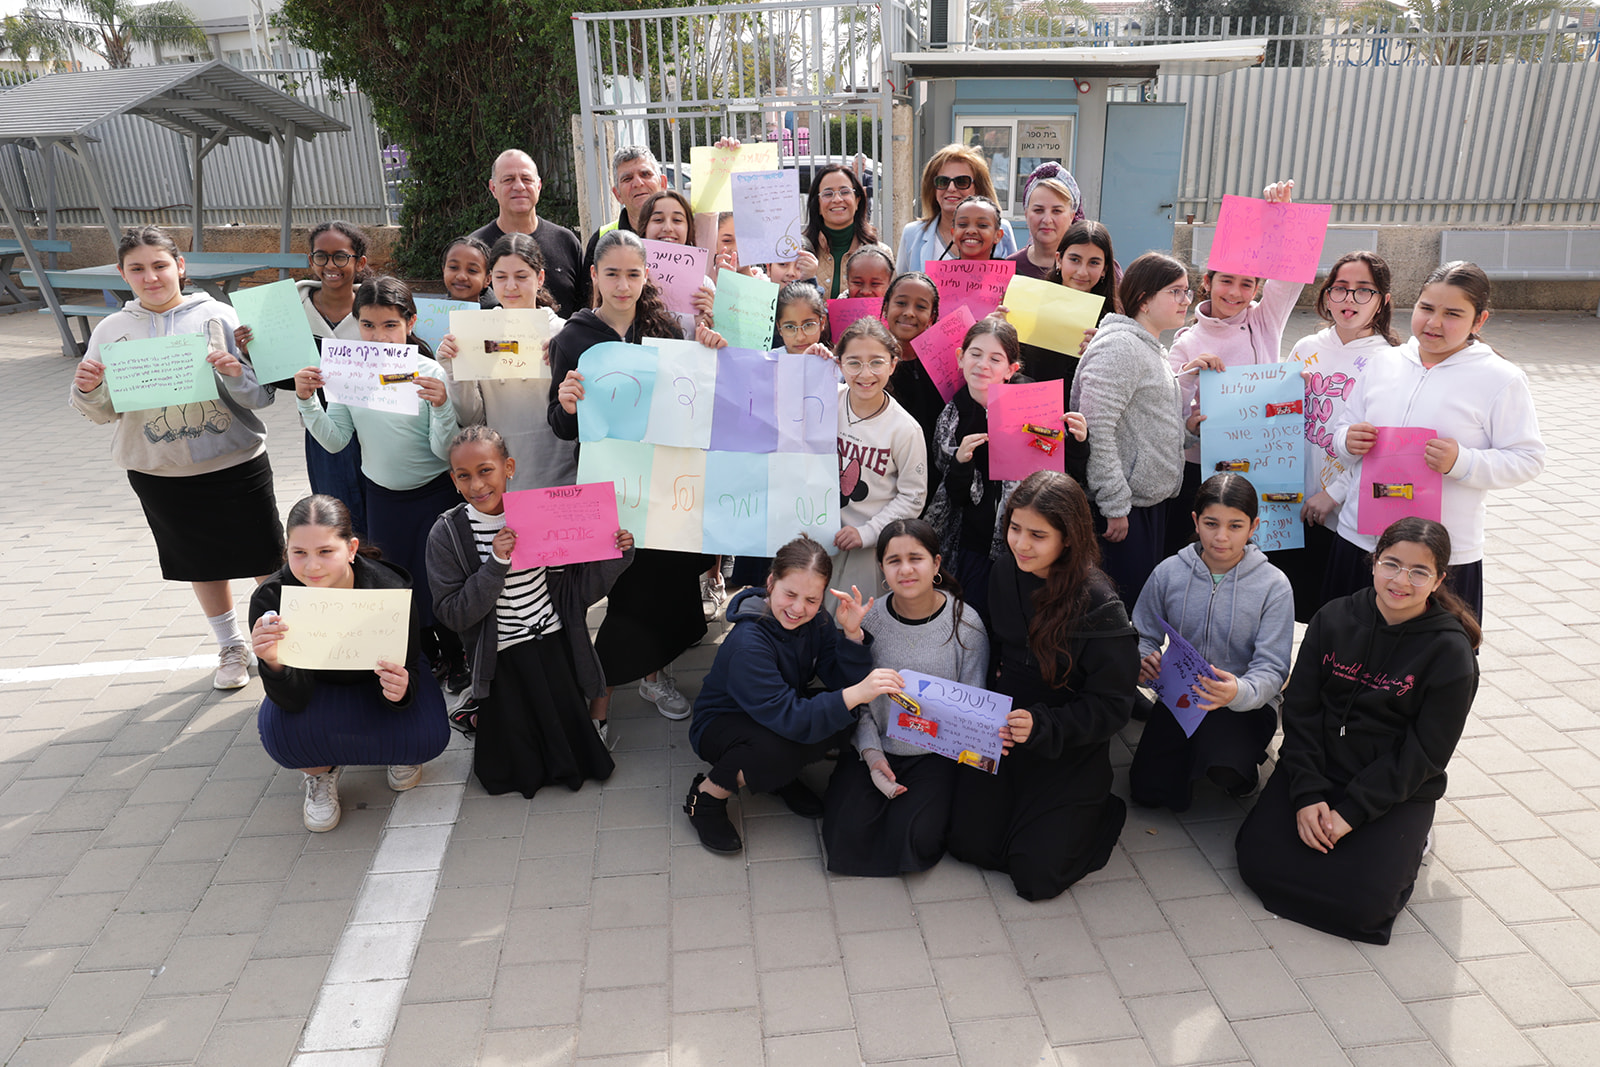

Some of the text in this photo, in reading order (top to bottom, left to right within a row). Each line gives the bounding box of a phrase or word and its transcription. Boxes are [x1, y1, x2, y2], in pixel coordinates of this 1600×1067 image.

[653, 252, 695, 266] השומר
[384, 347, 410, 357] לשומר
[1242, 365, 1287, 380] לשומר
[1221, 382, 1256, 394] שלנו!
[1224, 429, 1253, 440] שומר
[1261, 425, 1301, 441] שאתה
[837, 436, 890, 476] NNIE
[1254, 456, 1296, 471] קח לך
